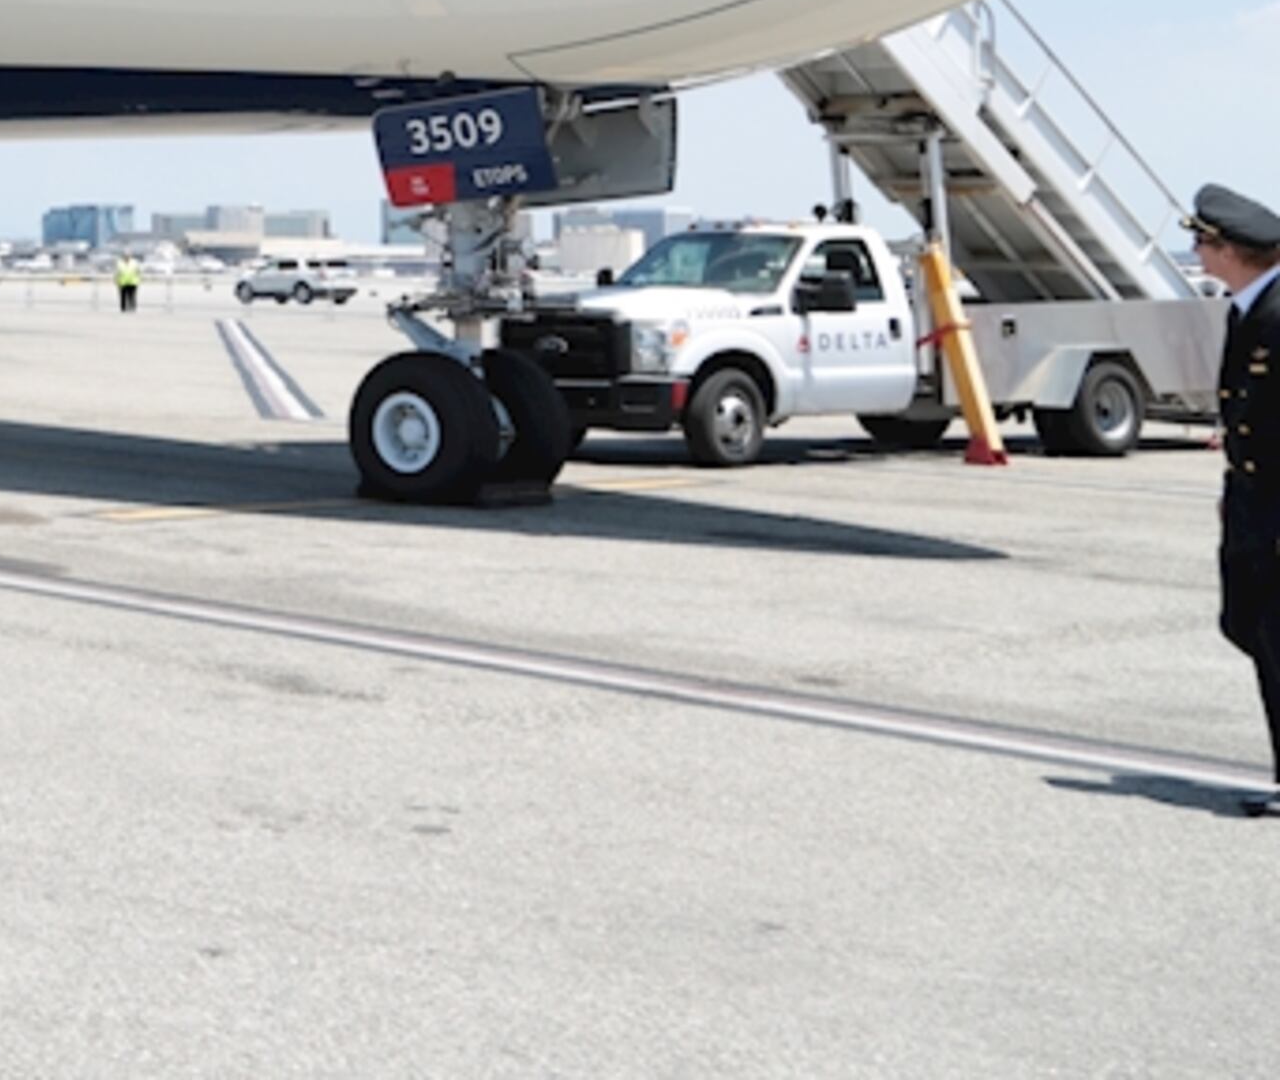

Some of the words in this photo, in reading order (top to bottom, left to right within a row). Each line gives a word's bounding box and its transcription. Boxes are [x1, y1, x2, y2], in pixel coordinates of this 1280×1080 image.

[406, 108, 502, 154] 3509
[473, 164, 528, 188] ETOPS
[818, 332, 887, 350] DELTA
